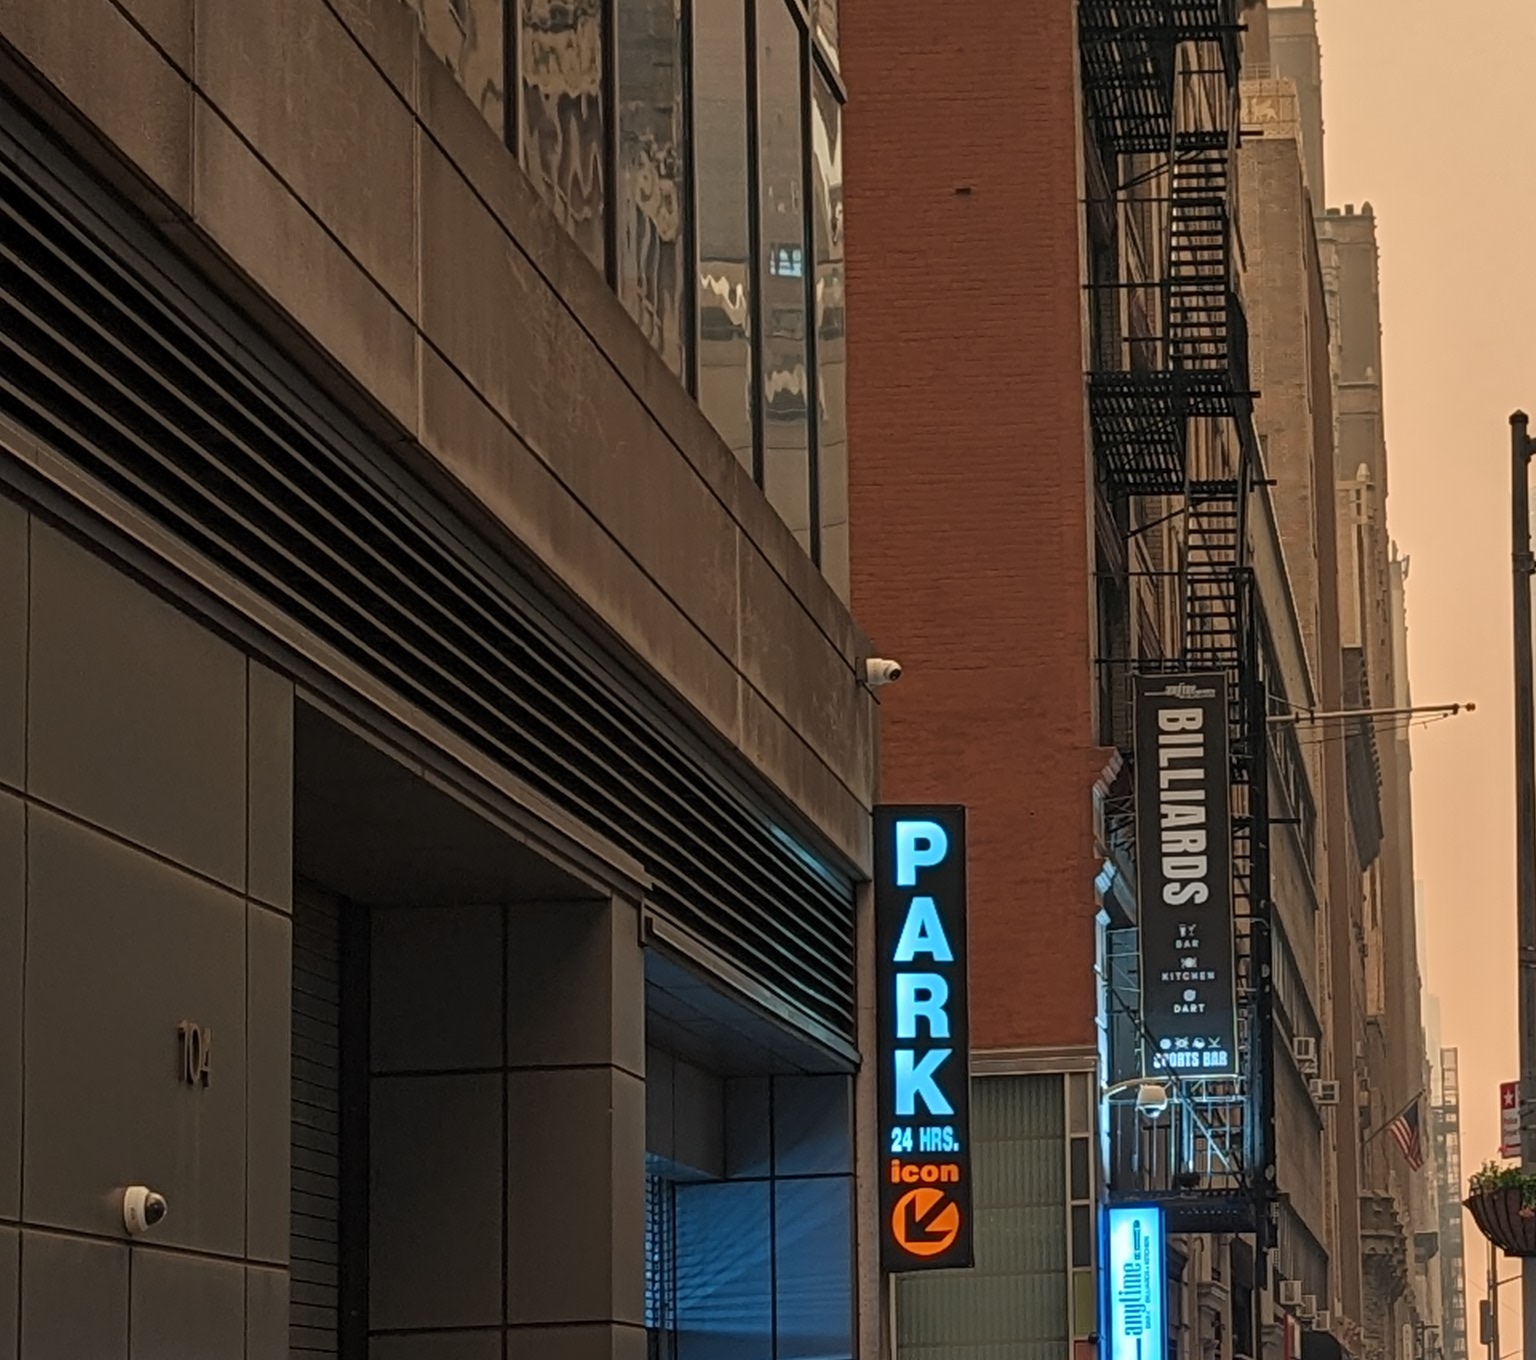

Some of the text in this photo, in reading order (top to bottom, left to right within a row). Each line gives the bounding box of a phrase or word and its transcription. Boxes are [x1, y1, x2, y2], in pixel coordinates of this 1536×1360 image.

[1157, 707, 1208, 907] BILLIARDS
[1175, 939, 1199, 949] BAR
[893, 821, 954, 1116] PARK
[1161, 971, 1215, 981] KITCHEN
[1173, 1003, 1205, 1013] DART
[178, 1020, 212, 1089] 104
[1202, 1051, 1228, 1067] BAR
[892, 1125, 959, 1152] 24 HRS.
[892, 1160, 959, 1184] icon
[1118, 1263, 1147, 1336] anytime
